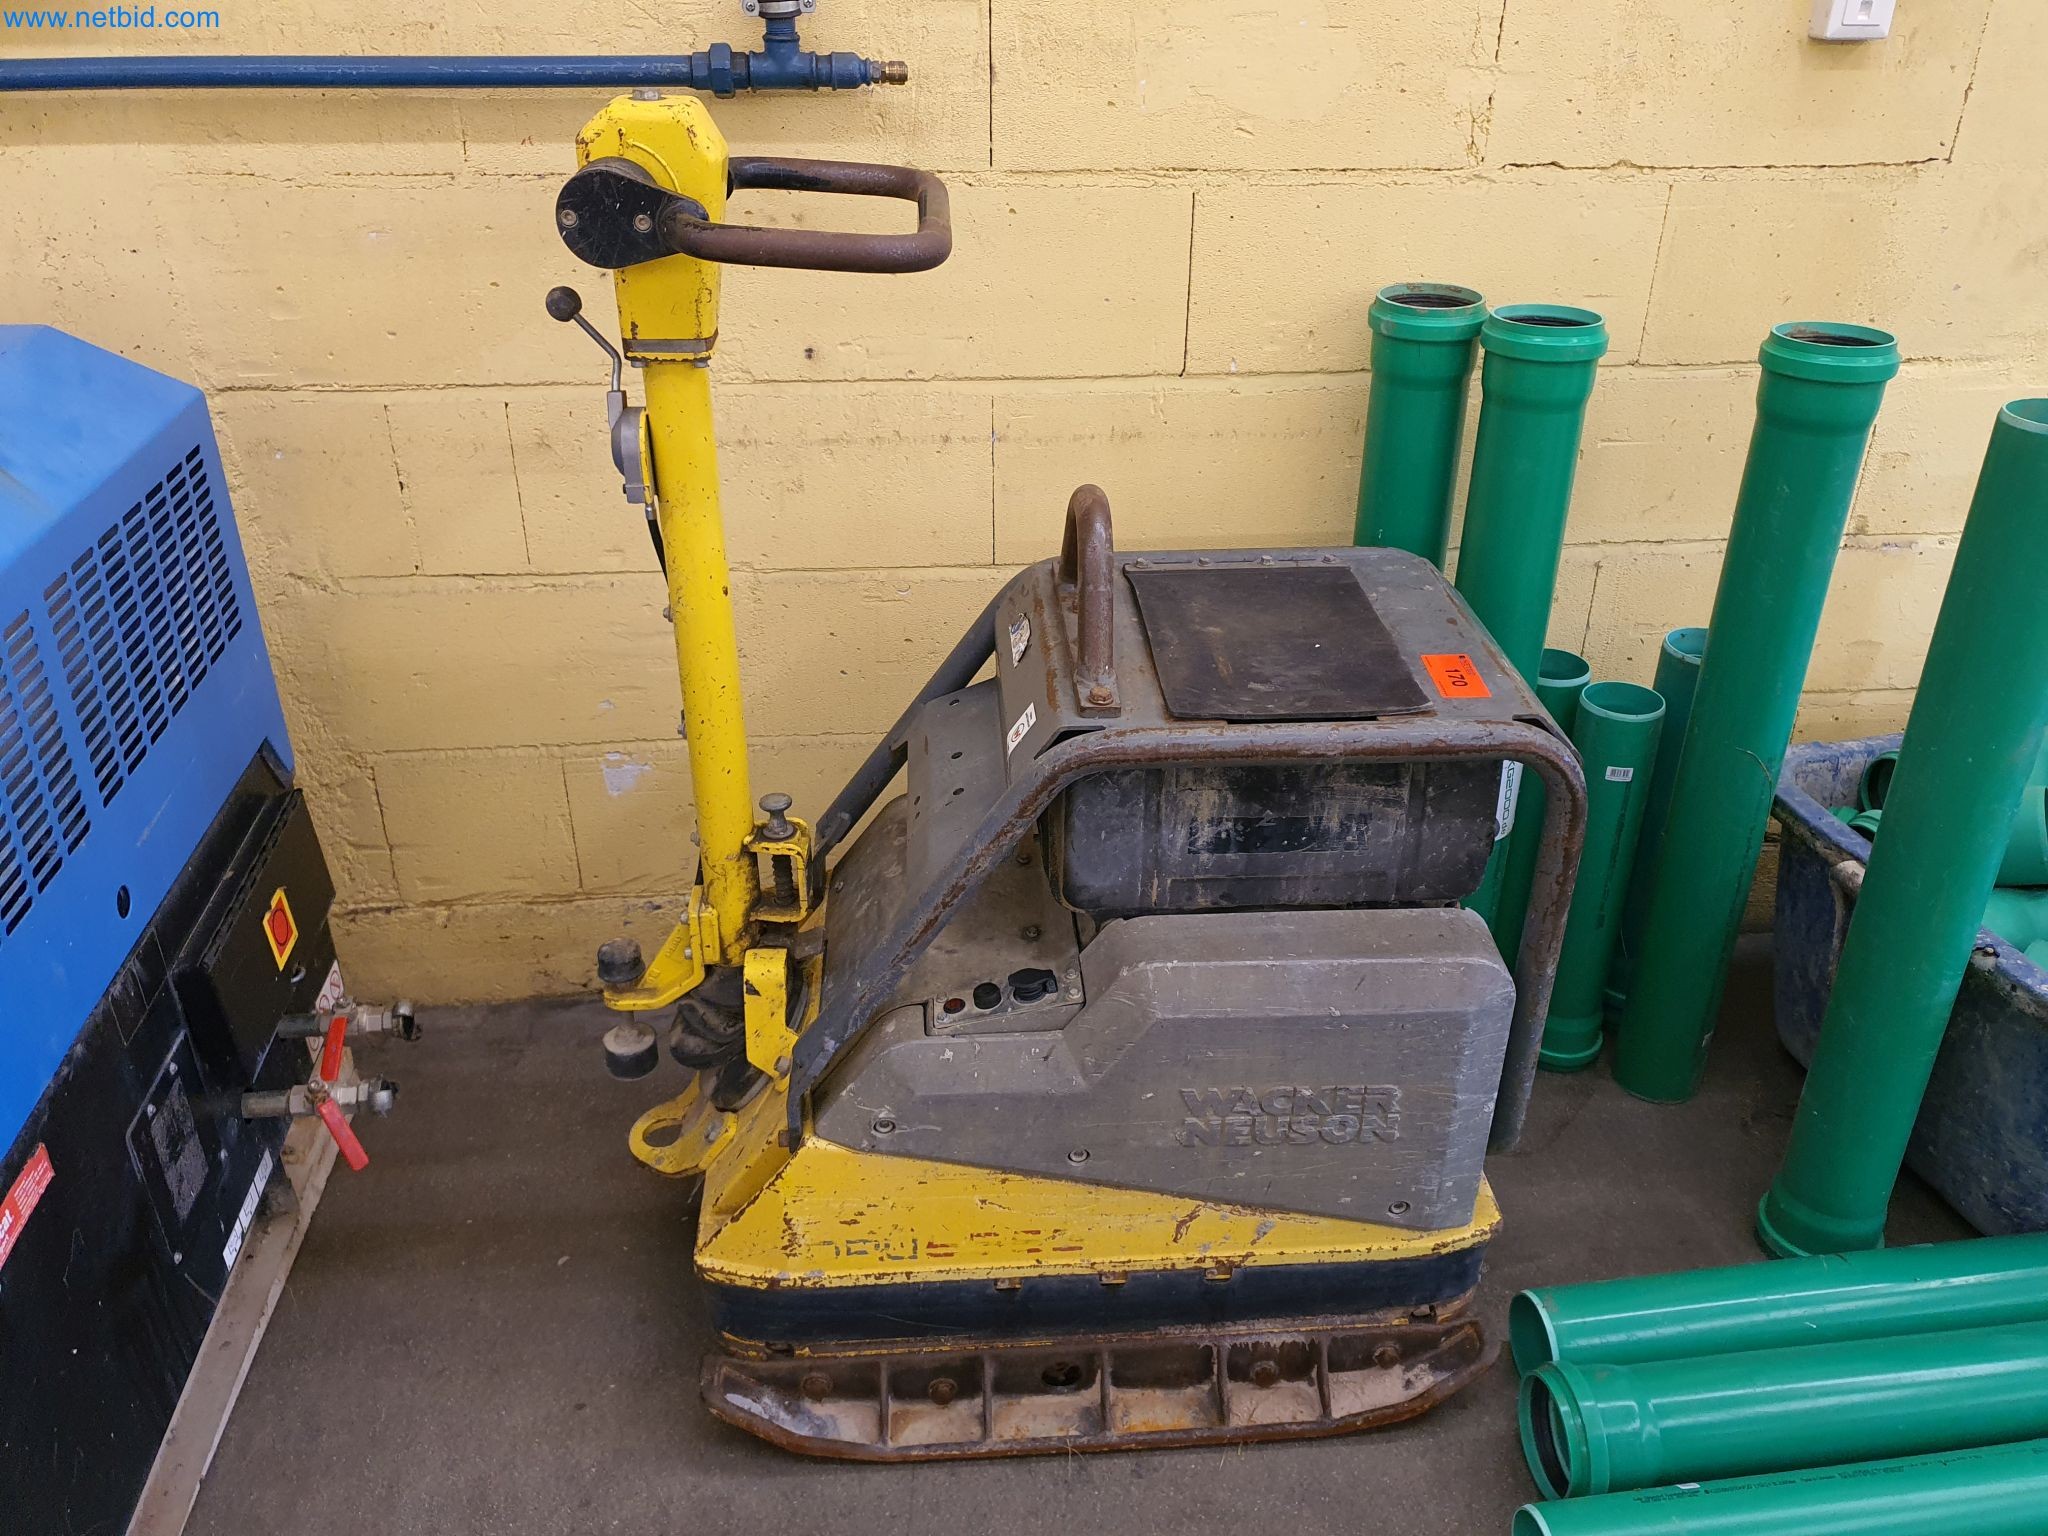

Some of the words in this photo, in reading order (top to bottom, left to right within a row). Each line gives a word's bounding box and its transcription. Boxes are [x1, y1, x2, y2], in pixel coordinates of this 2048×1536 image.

[1445, 669, 1468, 687] 170
[1178, 1084, 1402, 1116] WACKER
[1180, 1114, 1401, 1148] NEUSON
